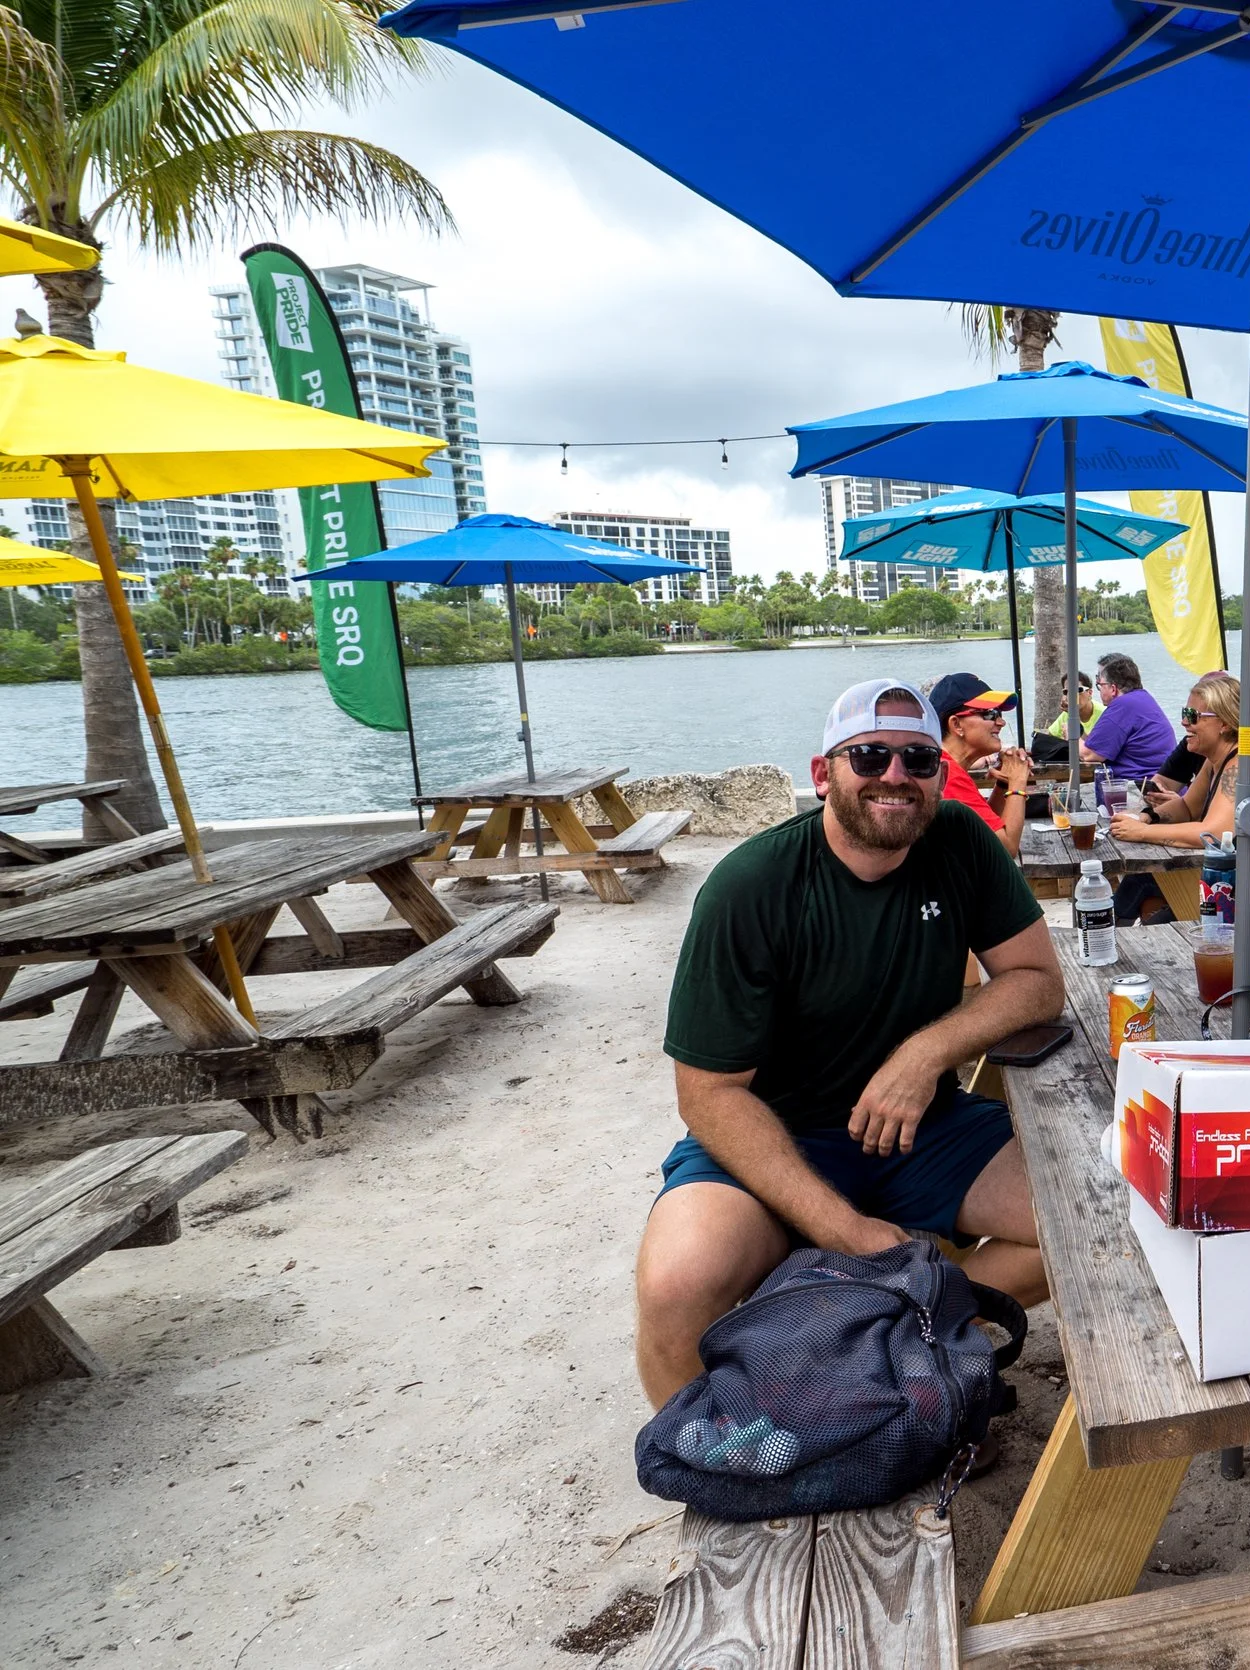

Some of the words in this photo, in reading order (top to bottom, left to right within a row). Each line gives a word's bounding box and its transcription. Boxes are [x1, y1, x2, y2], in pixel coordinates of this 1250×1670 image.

[276, 287, 305, 346] PRIDE
[286, 278, 308, 328] PROJECT
[323, 511, 354, 600] PRIE
[902, 551, 959, 564] LIGHT
[917, 544, 958, 556] BUD
[1027, 550, 1085, 563] LIGT
[331, 606, 365, 667] SRQ
[1195, 1129, 1241, 1143] Endless
